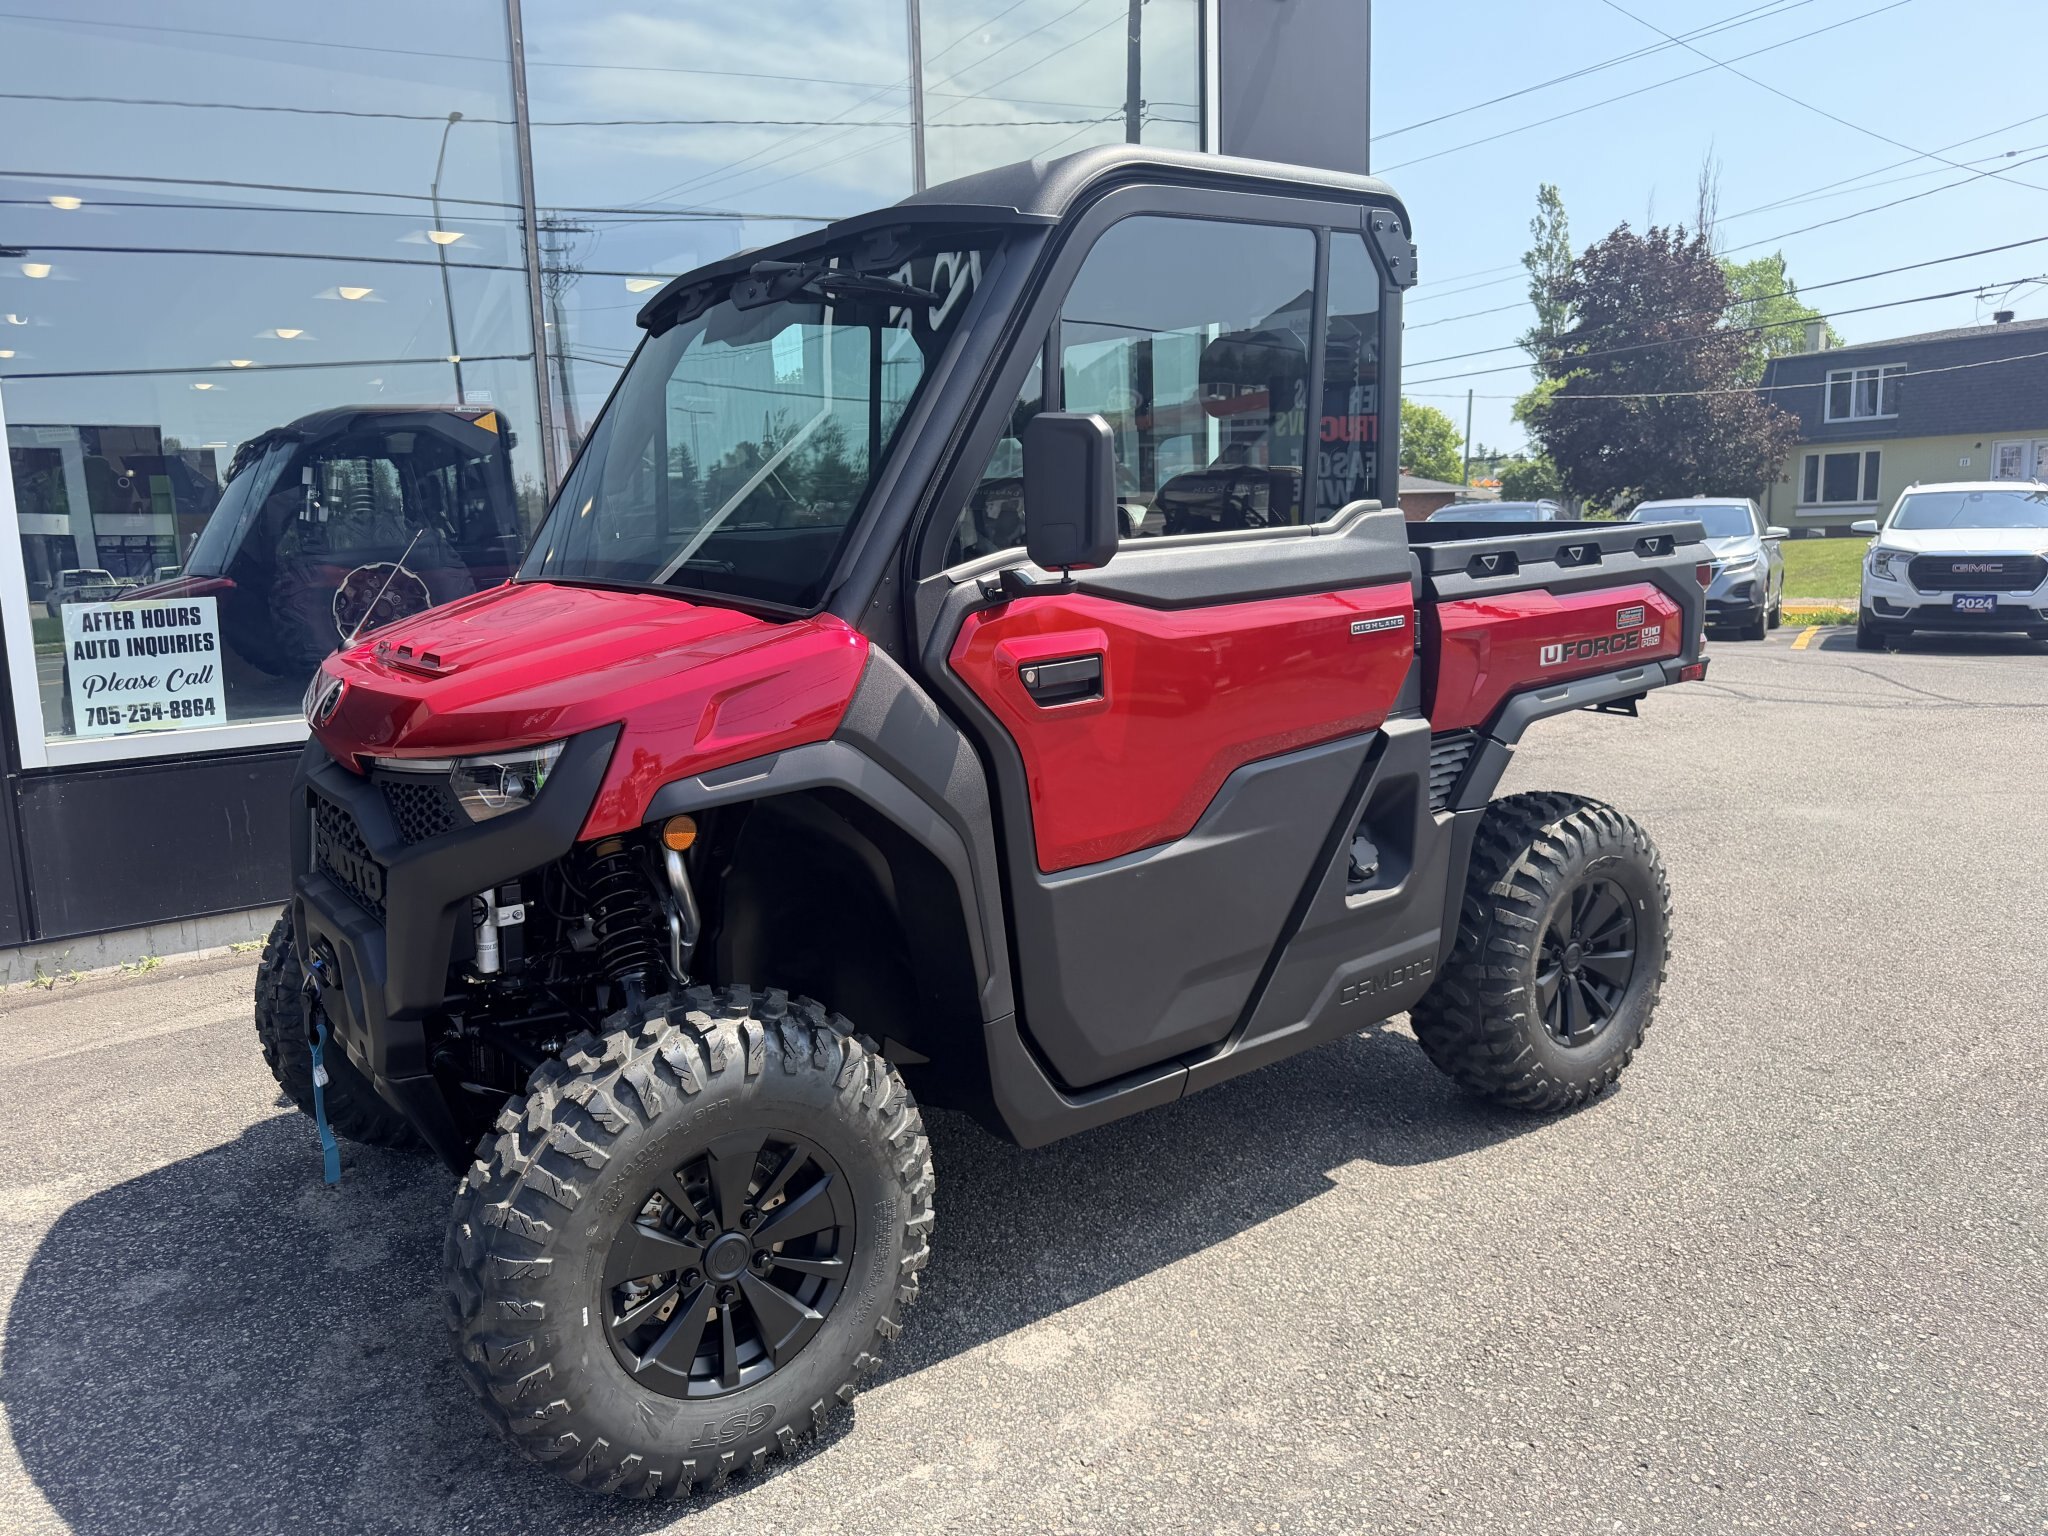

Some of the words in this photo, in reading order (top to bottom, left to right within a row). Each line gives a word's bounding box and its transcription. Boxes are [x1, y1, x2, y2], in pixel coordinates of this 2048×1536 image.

[1952, 563, 2003, 573] GMC
[1956, 598, 1993, 610] 2024
[82, 610, 135, 633] AFTER
[141, 606, 202, 629] HOURS
[1353, 618, 1403, 632] HIGHLAND
[73, 638, 120, 661] AUTO
[126, 632, 215, 658] INQUIRIES
[1641, 635, 1660, 648] PRO
[82, 671, 161, 699] Please
[166, 664, 214, 693] Call
[85, 697, 216, 727] 705-254-8864
[688, 1402, 777, 1451] CST
